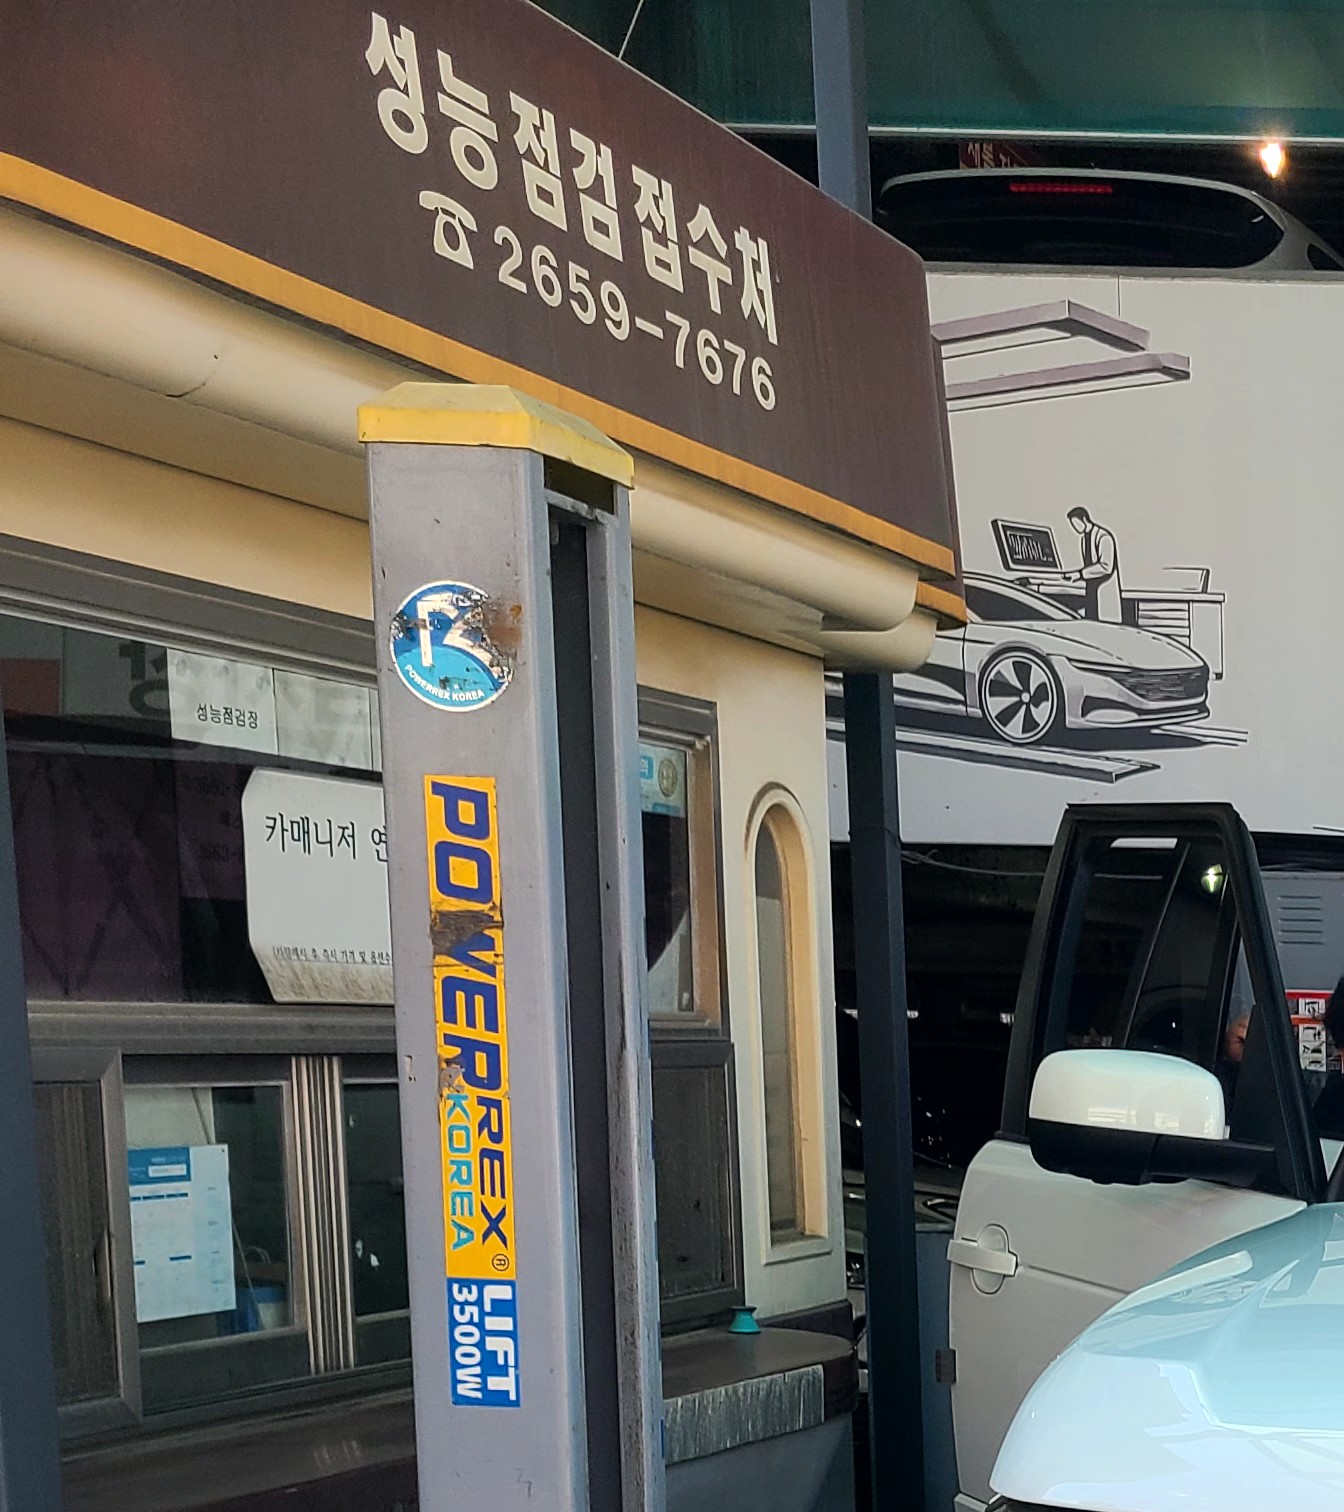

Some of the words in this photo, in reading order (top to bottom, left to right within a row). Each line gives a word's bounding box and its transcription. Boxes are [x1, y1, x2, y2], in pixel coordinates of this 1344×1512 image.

[493, 225, 776, 411] 2659-7676
[197, 703, 258, 729] 성능점검장
[452, 690, 485, 701] KOREA
[265, 812, 356, 860] 카매니저
[445, 1093, 477, 1251] KOREA
[451, 1284, 482, 1399] 3500W
[484, 1285, 517, 1401] LIFT
